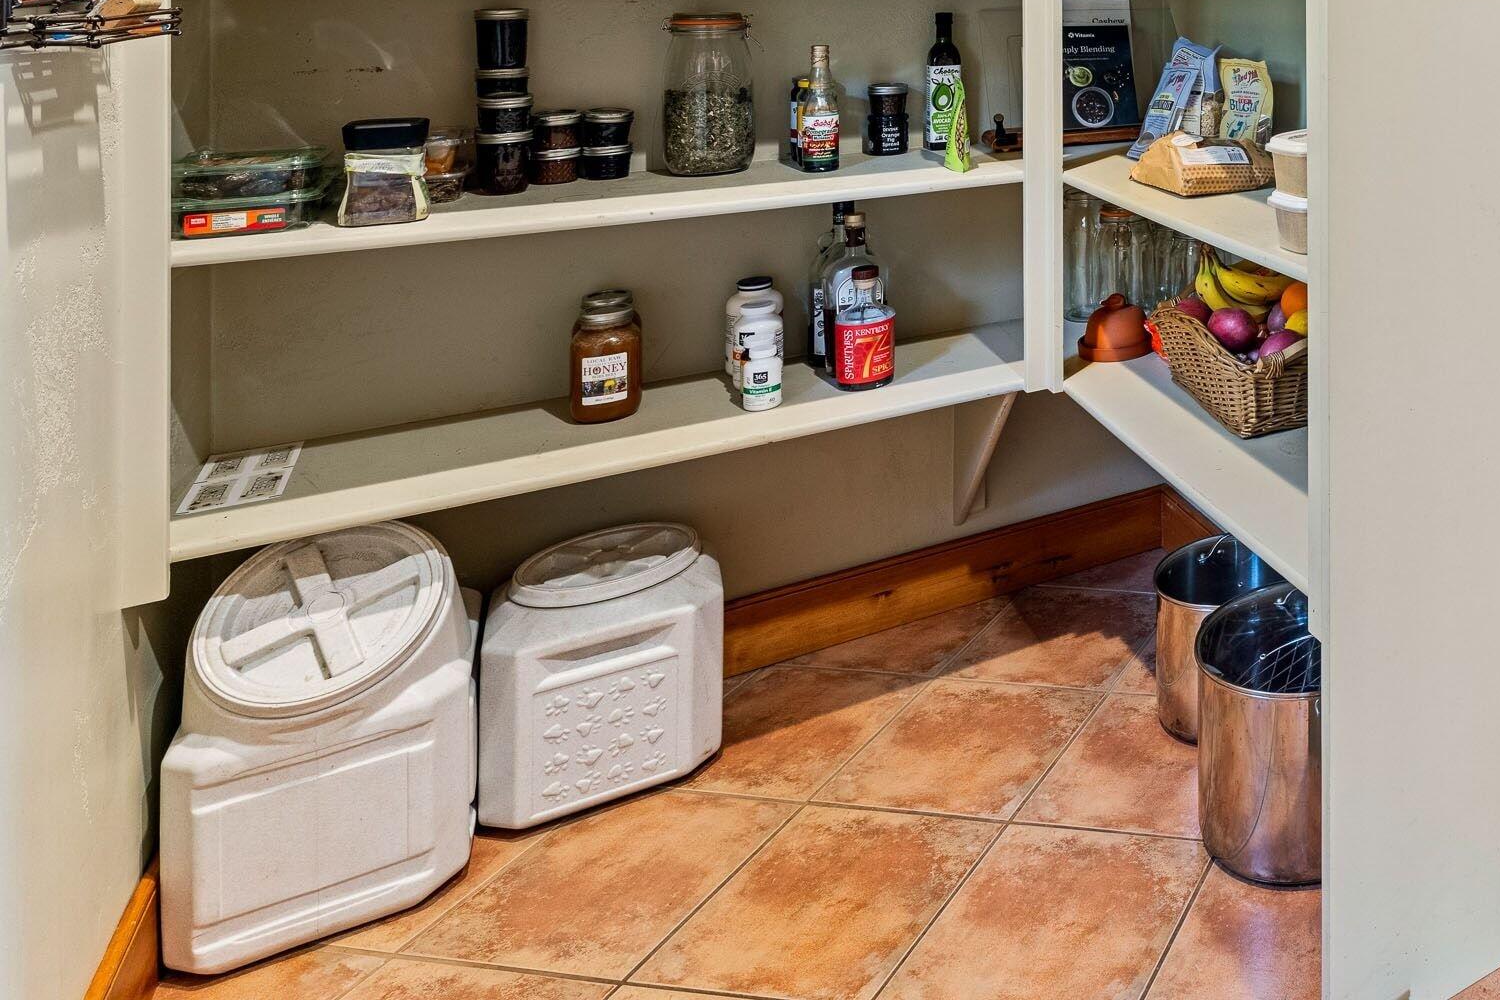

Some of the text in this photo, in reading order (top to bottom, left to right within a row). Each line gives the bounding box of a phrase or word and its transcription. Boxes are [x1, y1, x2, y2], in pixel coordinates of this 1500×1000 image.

[1080, 45, 1116, 53] Blending
[933, 67, 959, 75] Chosen
[813, 117, 834, 127] Sadaf
[855, 324, 889, 336] KENTUCKY
[583, 361, 627, 376] HONEY
[753, 373, 767, 381] 365
